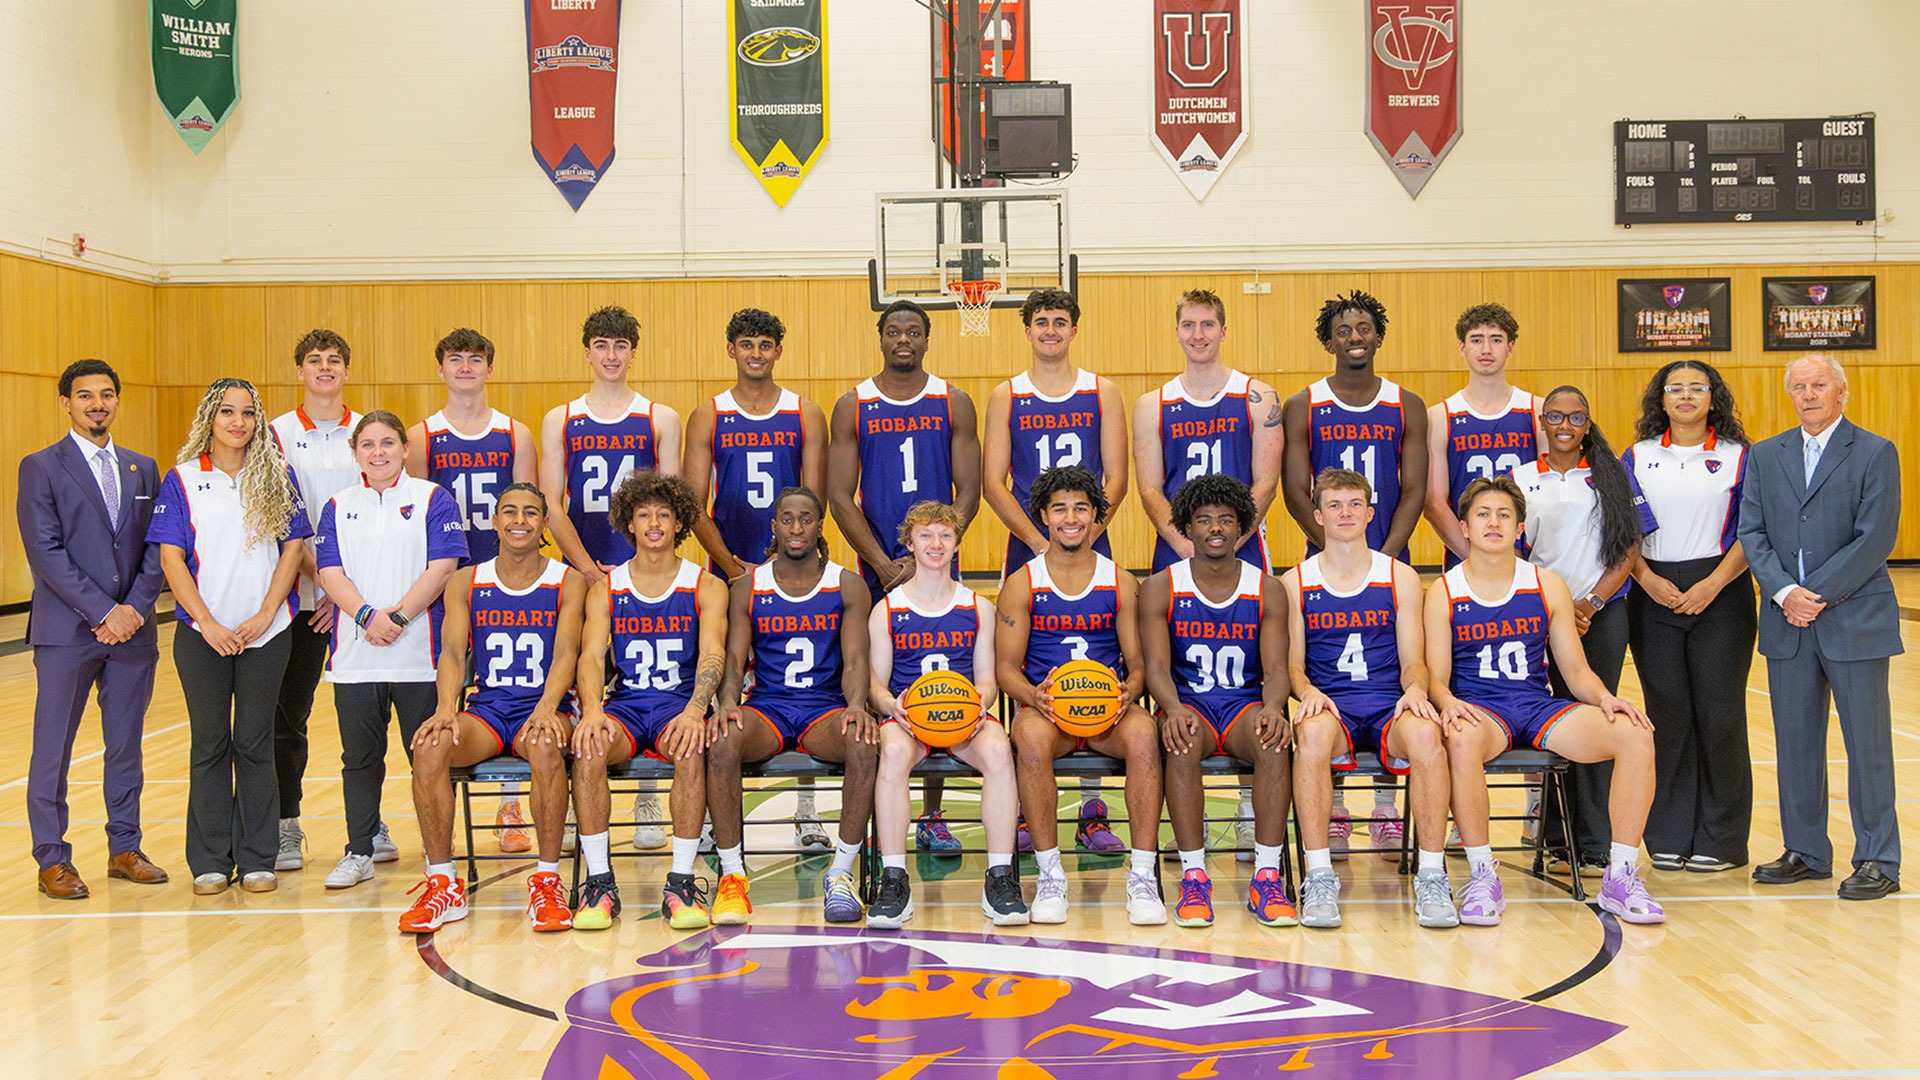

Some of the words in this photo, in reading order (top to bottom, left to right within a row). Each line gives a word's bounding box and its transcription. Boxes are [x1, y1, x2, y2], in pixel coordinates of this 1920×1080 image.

[551, 0, 596, 10] LIBERTY
[161, 13, 231, 35] WILLIAM
[171, 30, 220, 49] SMITH
[179, 48, 213, 58] HERONS
[537, 46, 574, 59] LIBERTY
[577, 46, 612, 59] LEAGUE
[1162, 12, 1233, 89] U
[1168, 97, 1227, 109] DUTCHMEN
[1388, 95, 1440, 107] BREWERS
[554, 107, 596, 119] LEAGUE
[737, 103, 822, 116] THOROUGHBREDS
[1160, 112, 1236, 125] DUTCHWOMEN
[1628, 124, 1667, 139] HOME
[1822, 121, 1865, 136] GUEST
[1711, 162, 1738, 171] PERIOD
[1626, 176, 1655, 187] FOULS
[1680, 178, 1694, 186] TOL
[1711, 177, 1738, 186] PLAYER
[1757, 176, 1775, 185] FOUL
[1797, 176, 1812, 184] TOL
[1837, 173, 1866, 184] FOULS
[868, 416, 942, 434] HOBART
[1020, 412, 1093, 430] HOBART
[1171, 418, 1238, 438] HOBART
[722, 432, 796, 448] HOBART
[1320, 425, 1394, 440] HOBART
[571, 435, 646, 451] HOBART
[1454, 432, 1530, 451] HOBART
[435, 452, 509, 469] HOBART
[1036, 433, 1081, 474] 12
[1187, 439, 1221, 481] 21
[900, 437, 917, 492] 1
[747, 452, 773, 508] 5
[451, 473, 497, 531] 15
[476, 610, 556, 626] HOBART
[615, 616, 691, 633] HOBART
[758, 614, 838, 632] HOBART
[1034, 614, 1112, 630] HOBART
[1307, 610, 1389, 629] HOBART
[1176, 622, 1256, 639] HOBART
[1457, 617, 1540, 640] HOBART
[895, 632, 974, 649] HOBART
[486, 633, 544, 687] 23
[623, 639, 683, 690] 35
[785, 638, 814, 688] 2
[1337, 633, 1368, 681] 4
[1477, 641, 1530, 680] 10
[1186, 644, 1245, 693] 30
[918, 683, 970, 698] Wilson
[1060, 676, 1111, 692] Wilson
[927, 709, 964, 722] NCAA
[1068, 704, 1106, 716] NCAA
